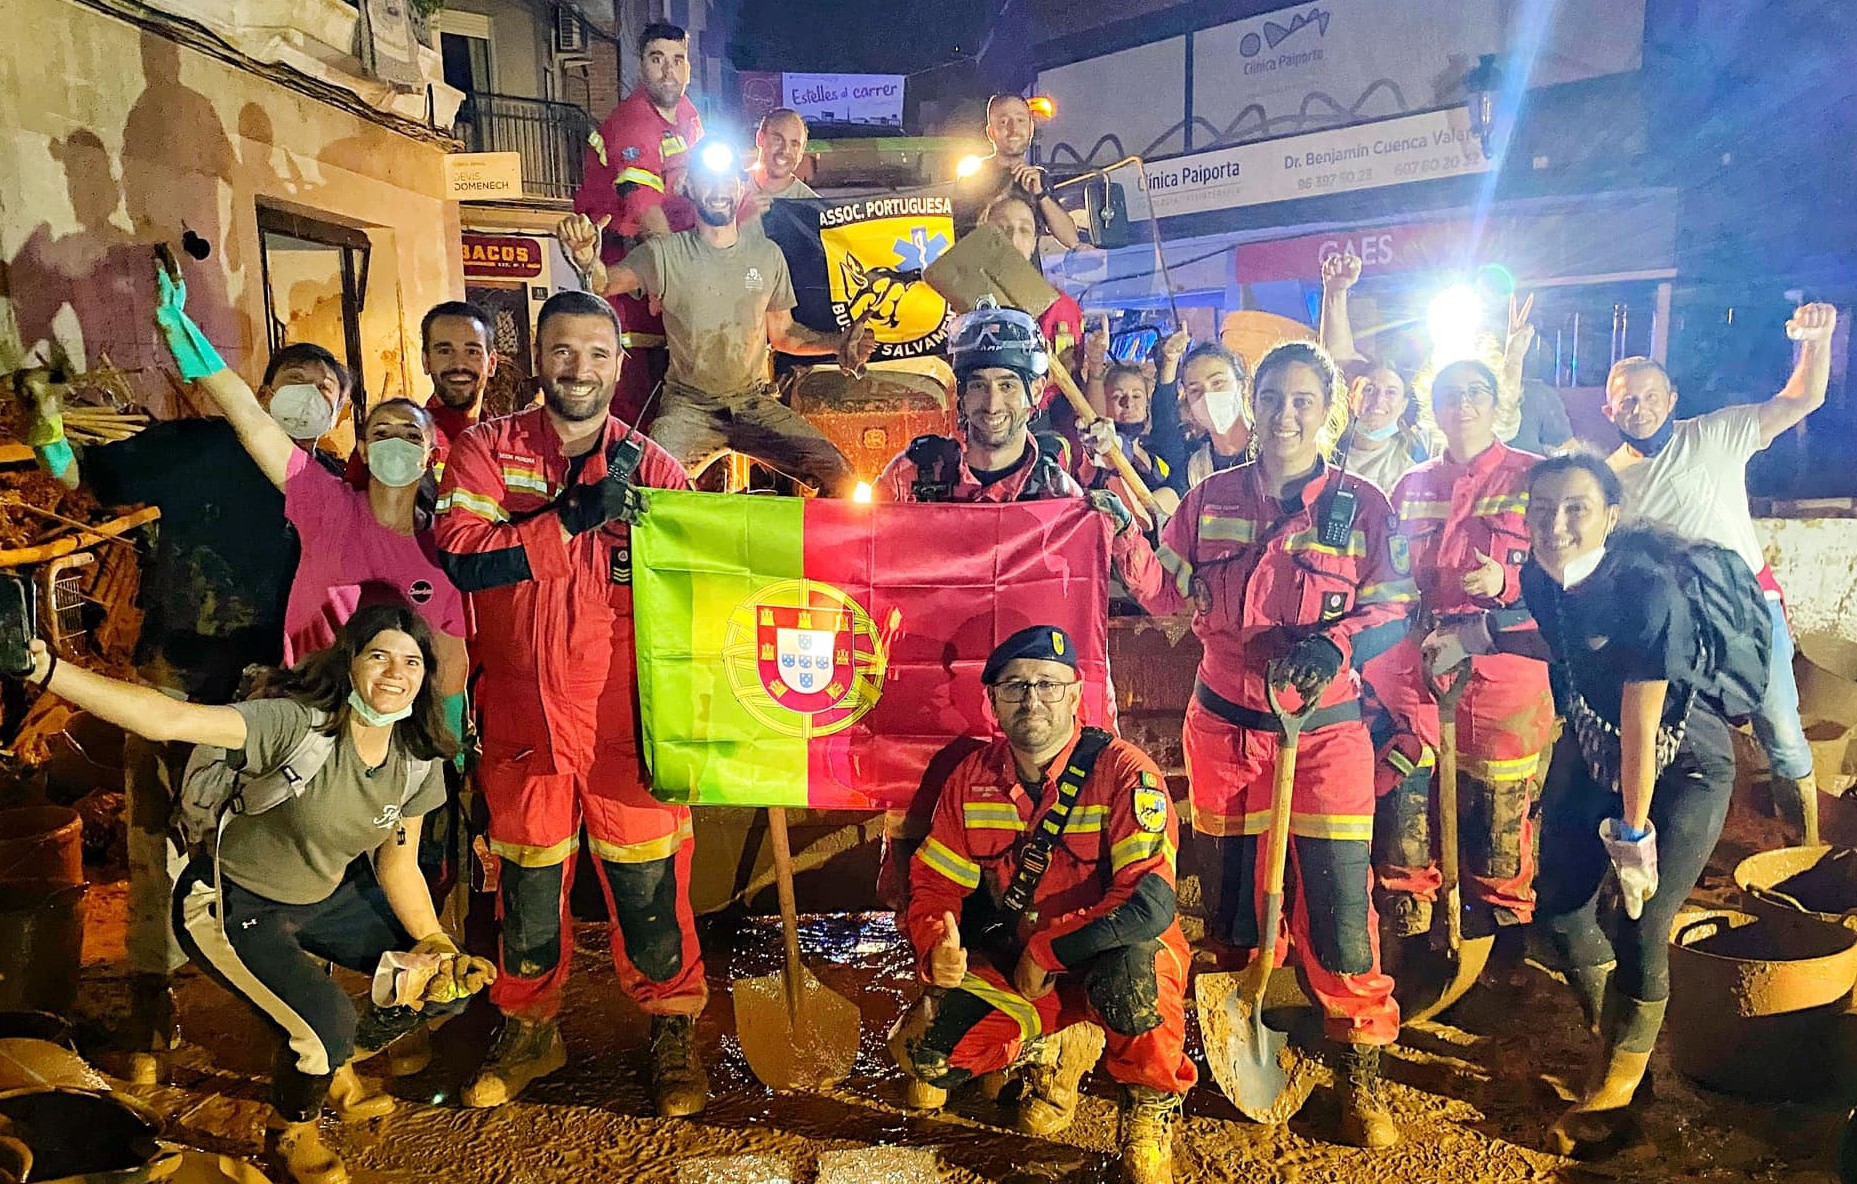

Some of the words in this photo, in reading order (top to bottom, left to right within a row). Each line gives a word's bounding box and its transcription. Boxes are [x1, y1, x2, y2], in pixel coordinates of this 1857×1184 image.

[1279, 50, 1323, 67] Paiporta
[791, 84, 839, 105] Estelles
[852, 84, 898, 99] carrer
[1284, 154, 1302, 170] Dr.
[1305, 142, 1370, 167] Benjamín
[1373, 134, 1428, 155] Cuenca
[1432, 126, 1478, 147] Valer
[454, 181, 509, 191] DOMENECH
[1137, 171, 1178, 192] Cínica
[1181, 160, 1241, 186] Paiporta
[819, 203, 865, 226] ASSOC.
[865, 197, 953, 218] PORTUGUESA
